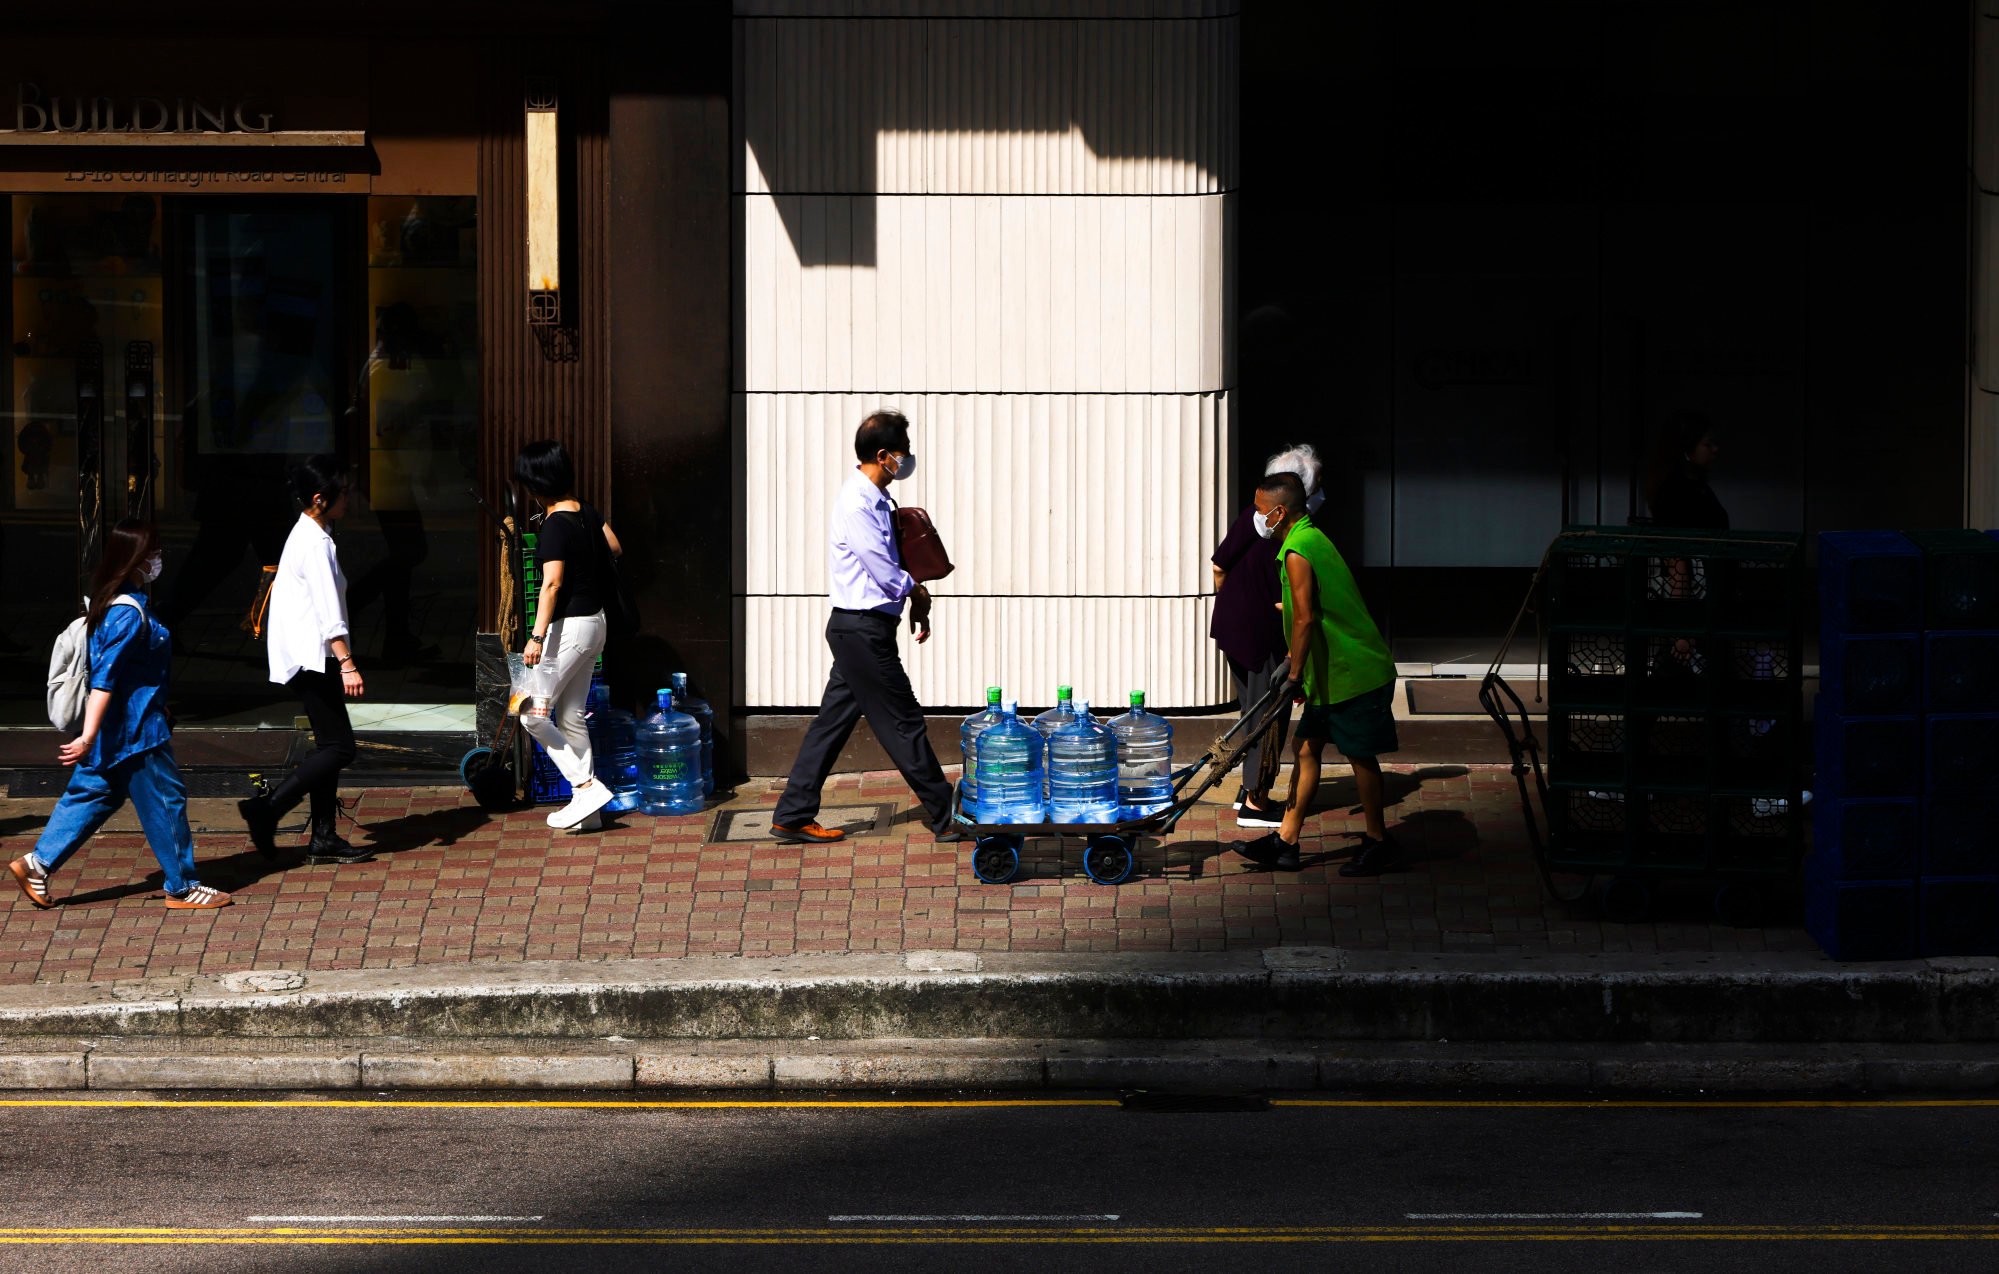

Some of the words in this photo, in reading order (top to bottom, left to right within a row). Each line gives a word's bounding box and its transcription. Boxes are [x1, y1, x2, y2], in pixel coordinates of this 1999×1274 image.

[16, 80, 274, 133] BUILDING
[119, 167, 220, 188] Connaught
[225, 167, 274, 182] Road
[281, 167, 347, 183] Central
